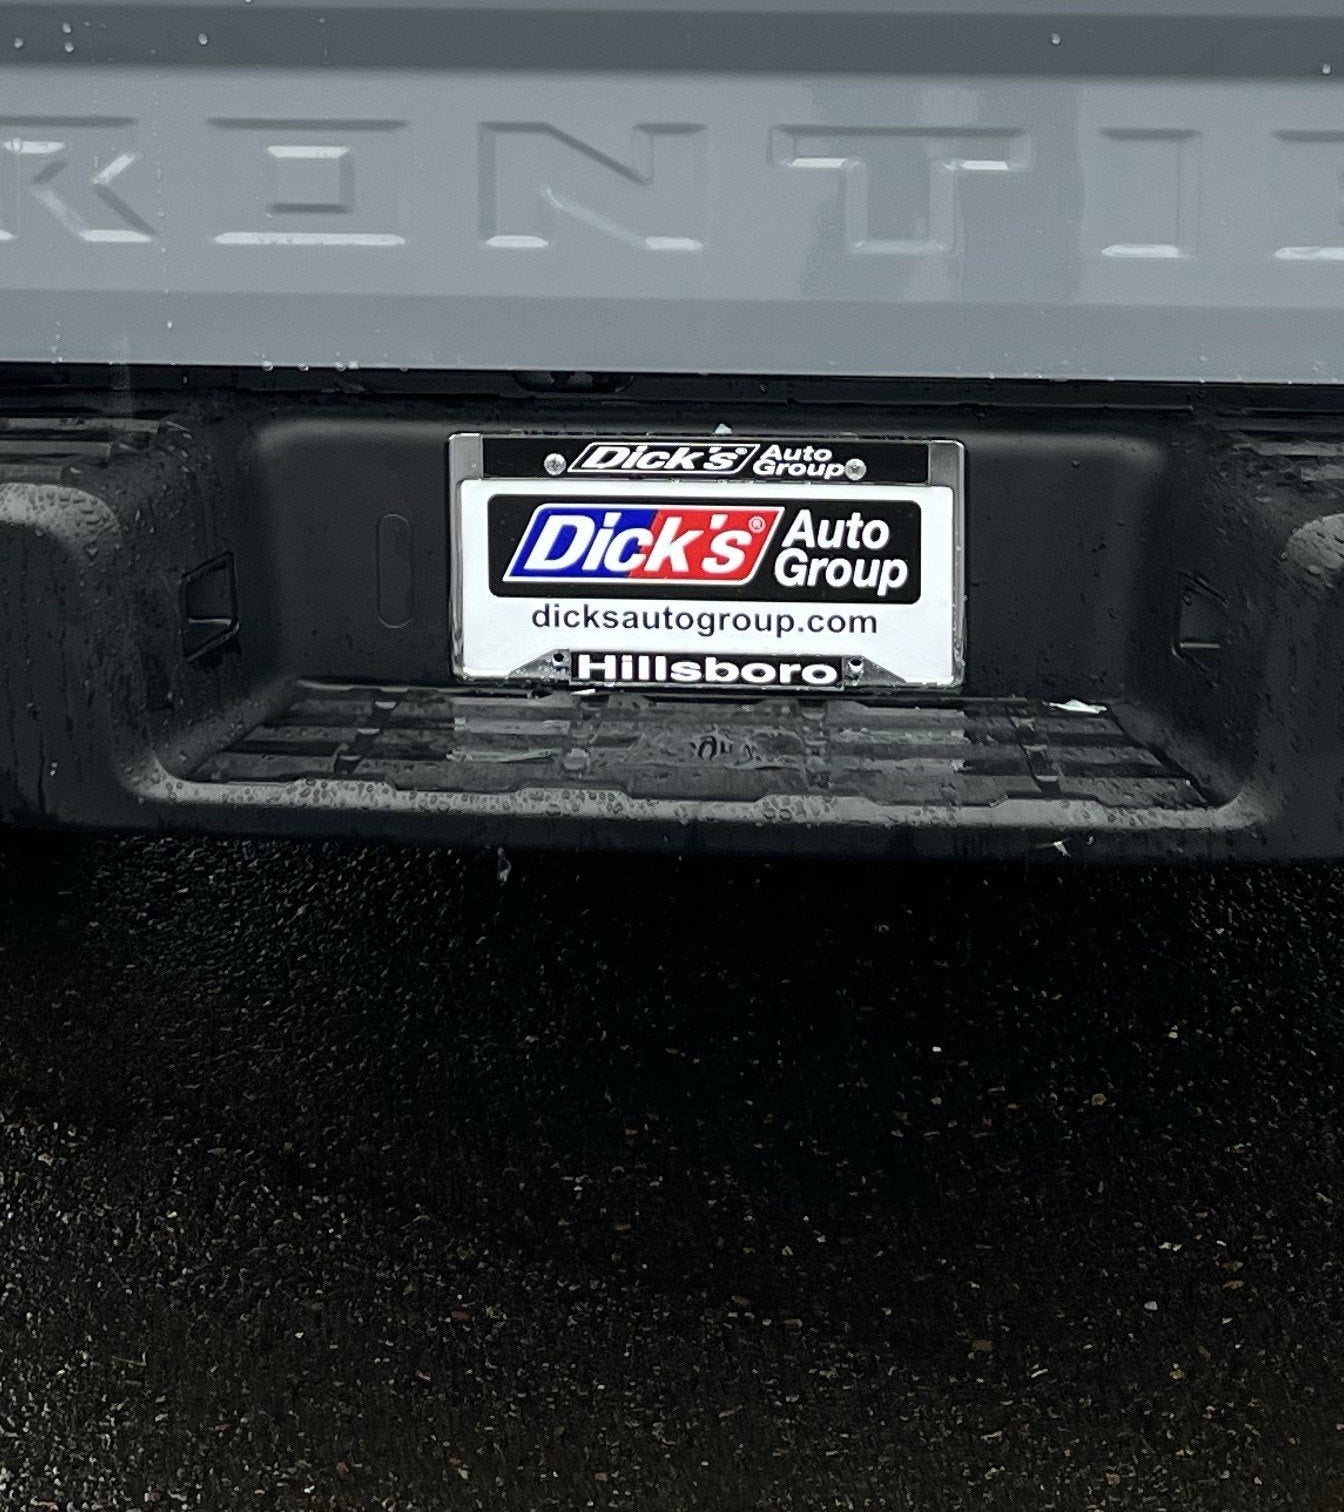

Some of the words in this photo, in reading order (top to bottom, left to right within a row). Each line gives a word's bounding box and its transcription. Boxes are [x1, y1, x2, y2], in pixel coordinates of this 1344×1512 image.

[581, 445, 740, 471] Dick's
[752, 458, 846, 480] Group
[759, 444, 833, 462] Auto
[522, 512, 753, 575] Dick's
[781, 509, 890, 550] Auto
[773, 546, 910, 597] Group
[531, 602, 878, 637] dicksautogroup.com
[576, 654, 839, 686] Hillsboro
